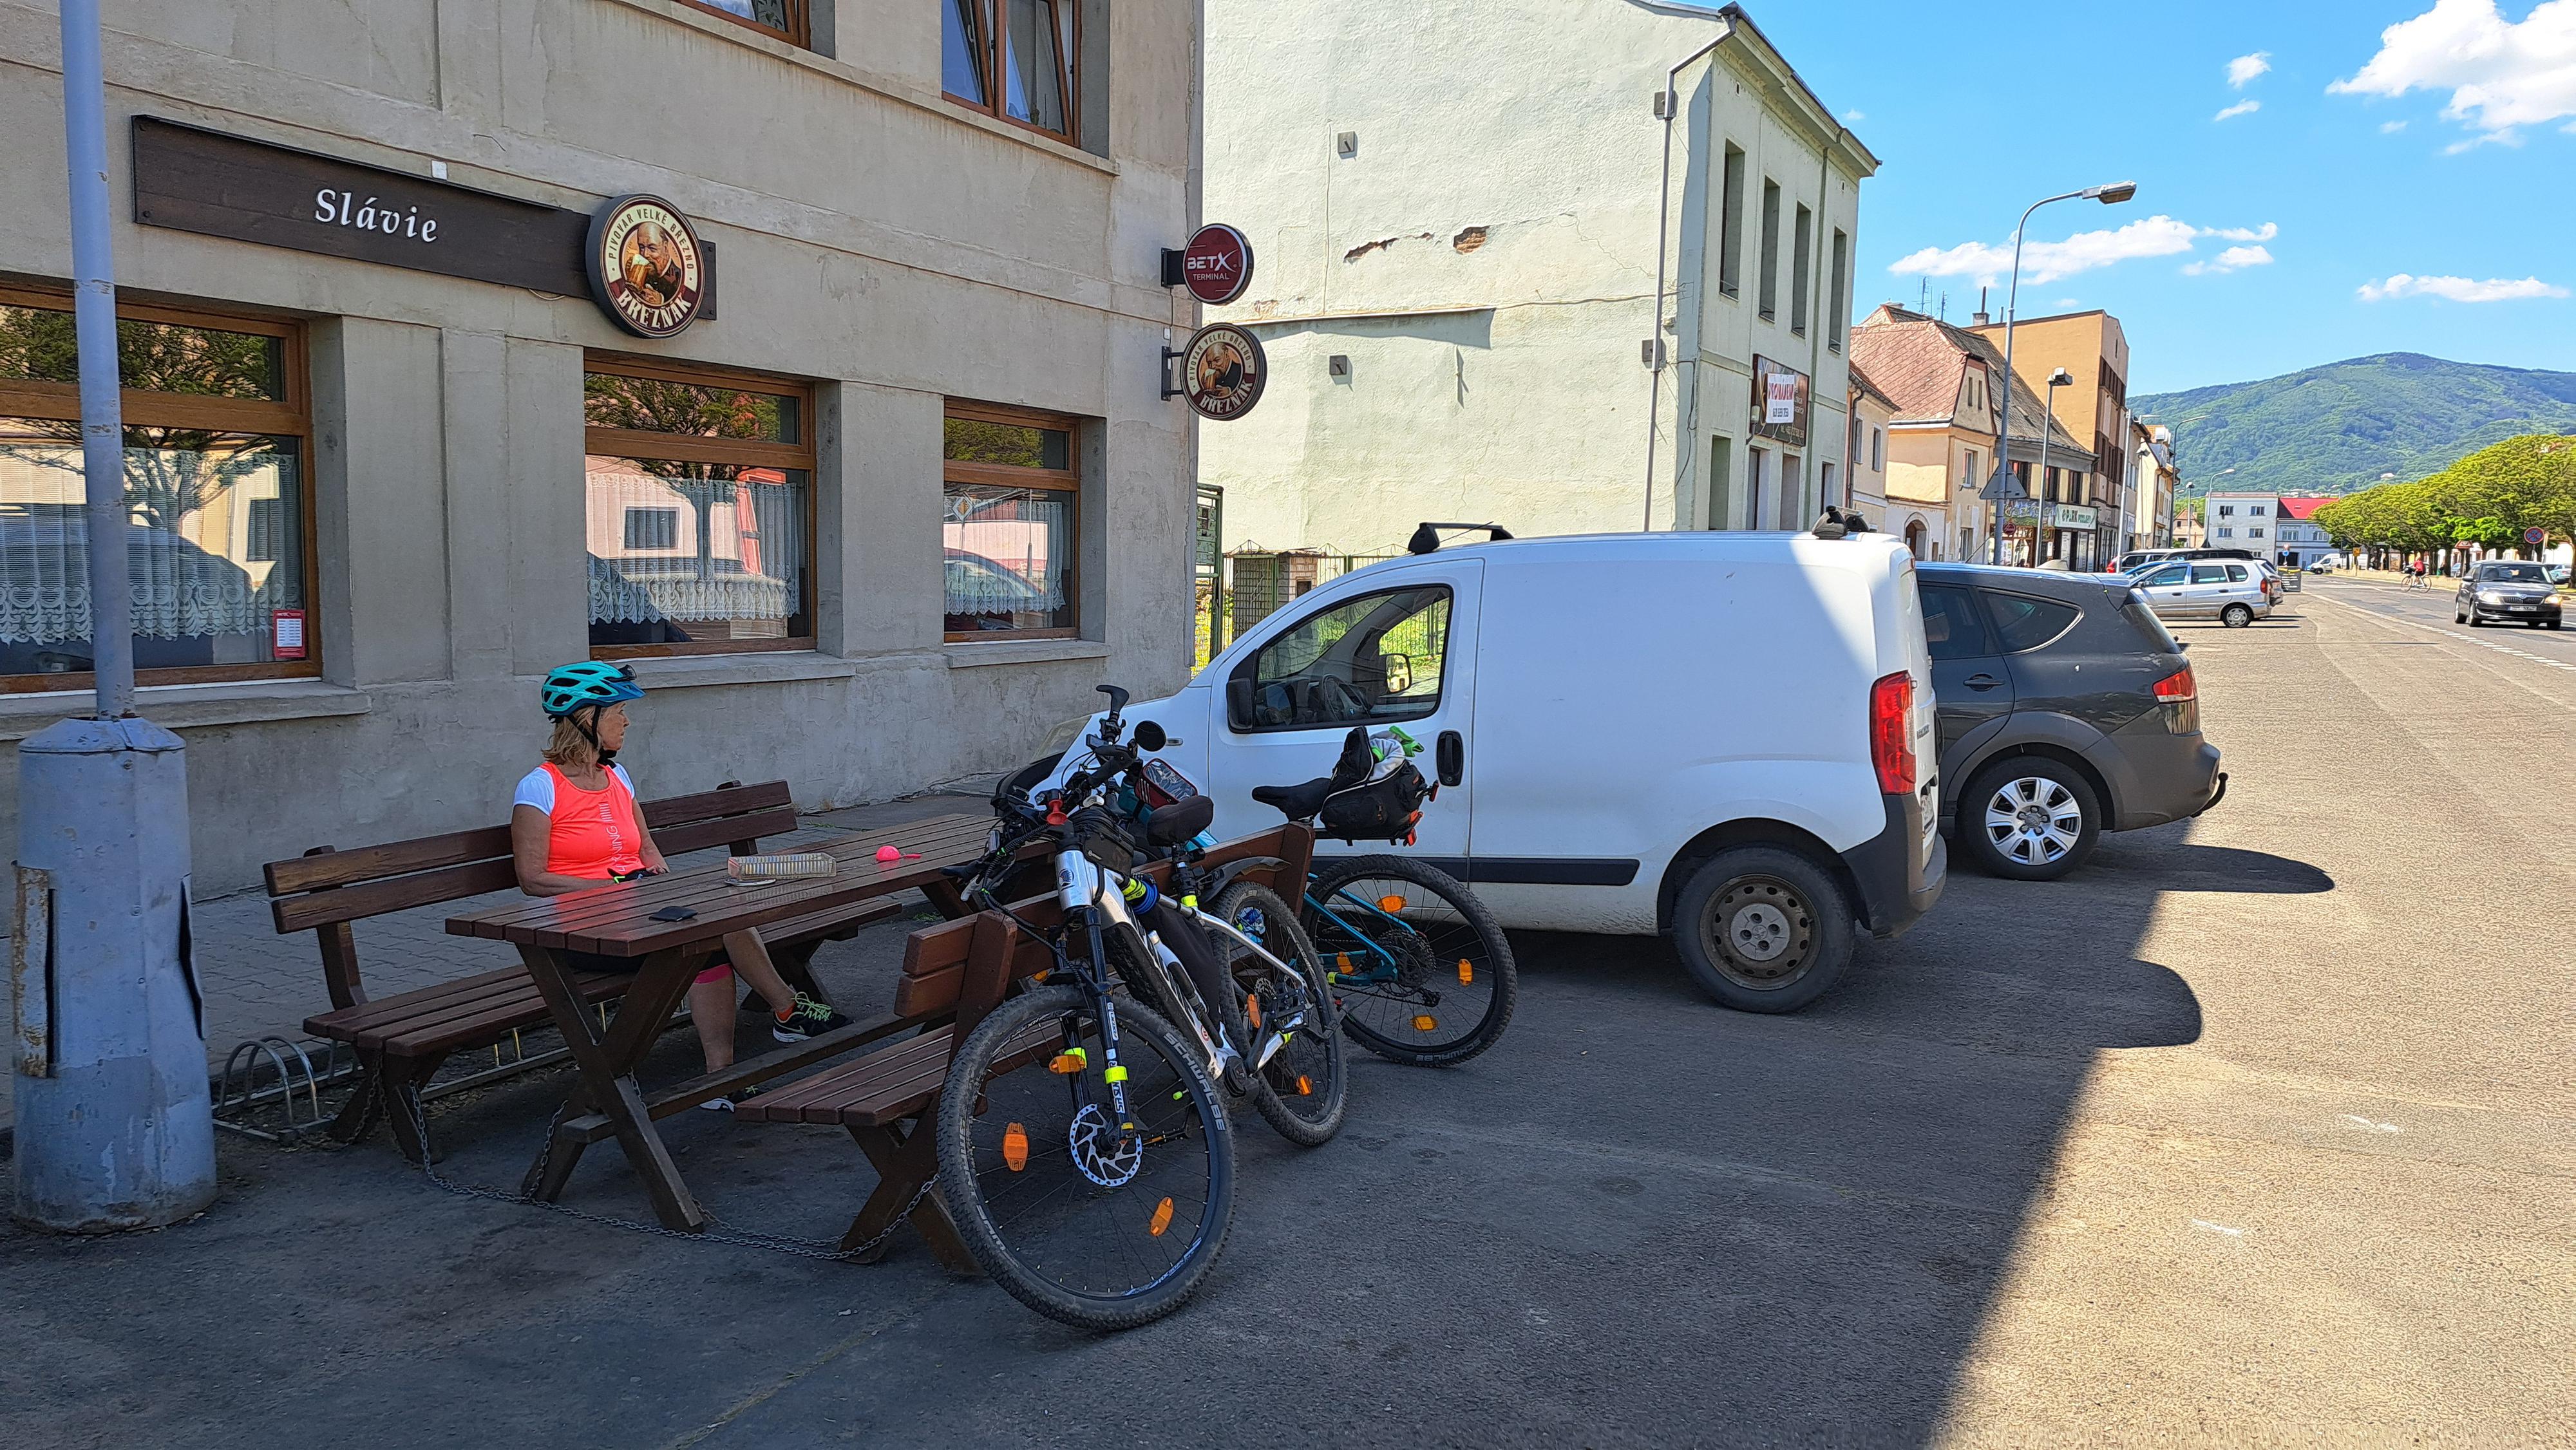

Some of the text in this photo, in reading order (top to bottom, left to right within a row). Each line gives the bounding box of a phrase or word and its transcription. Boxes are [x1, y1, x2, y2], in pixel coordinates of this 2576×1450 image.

[315, 189, 437, 242] Slávie
[609, 208, 694, 269] PIVOVAR VELKÉ BŘEZNO
[1193, 272, 1230, 281] TERMINAL
[1189, 332, 1251, 381] PIVOVAR VELKÉ BŘEZNO
[1109, 1062, 1121, 1097] SUNR
[1163, 1032, 1226, 1131] SCHWALBE
